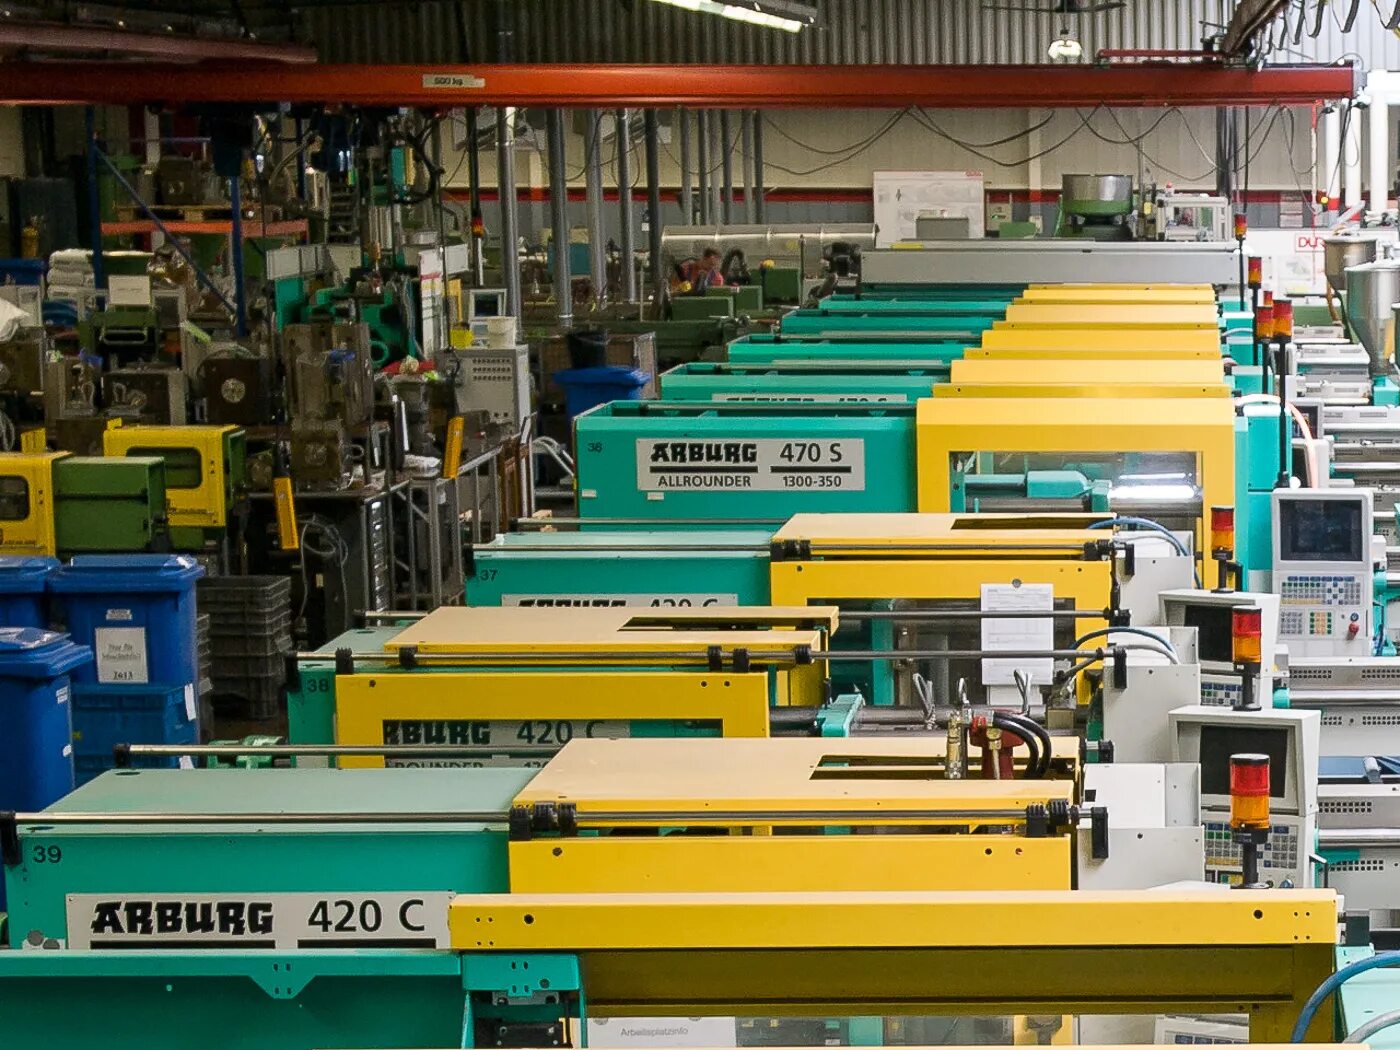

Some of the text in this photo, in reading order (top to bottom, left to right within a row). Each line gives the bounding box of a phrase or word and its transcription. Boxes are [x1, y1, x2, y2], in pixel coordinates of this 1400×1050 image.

[650, 443, 842, 463] ARBURG 470 S
[657, 475, 842, 488] ALLROUNDER 1300-350
[480, 569, 498, 581] 37
[307, 678, 329, 692] 38
[383, 720, 491, 745] RBURG
[516, 720, 573, 744] 420
[32, 845, 62, 864] 39
[90, 900, 425, 935] ARBURG 420 C
